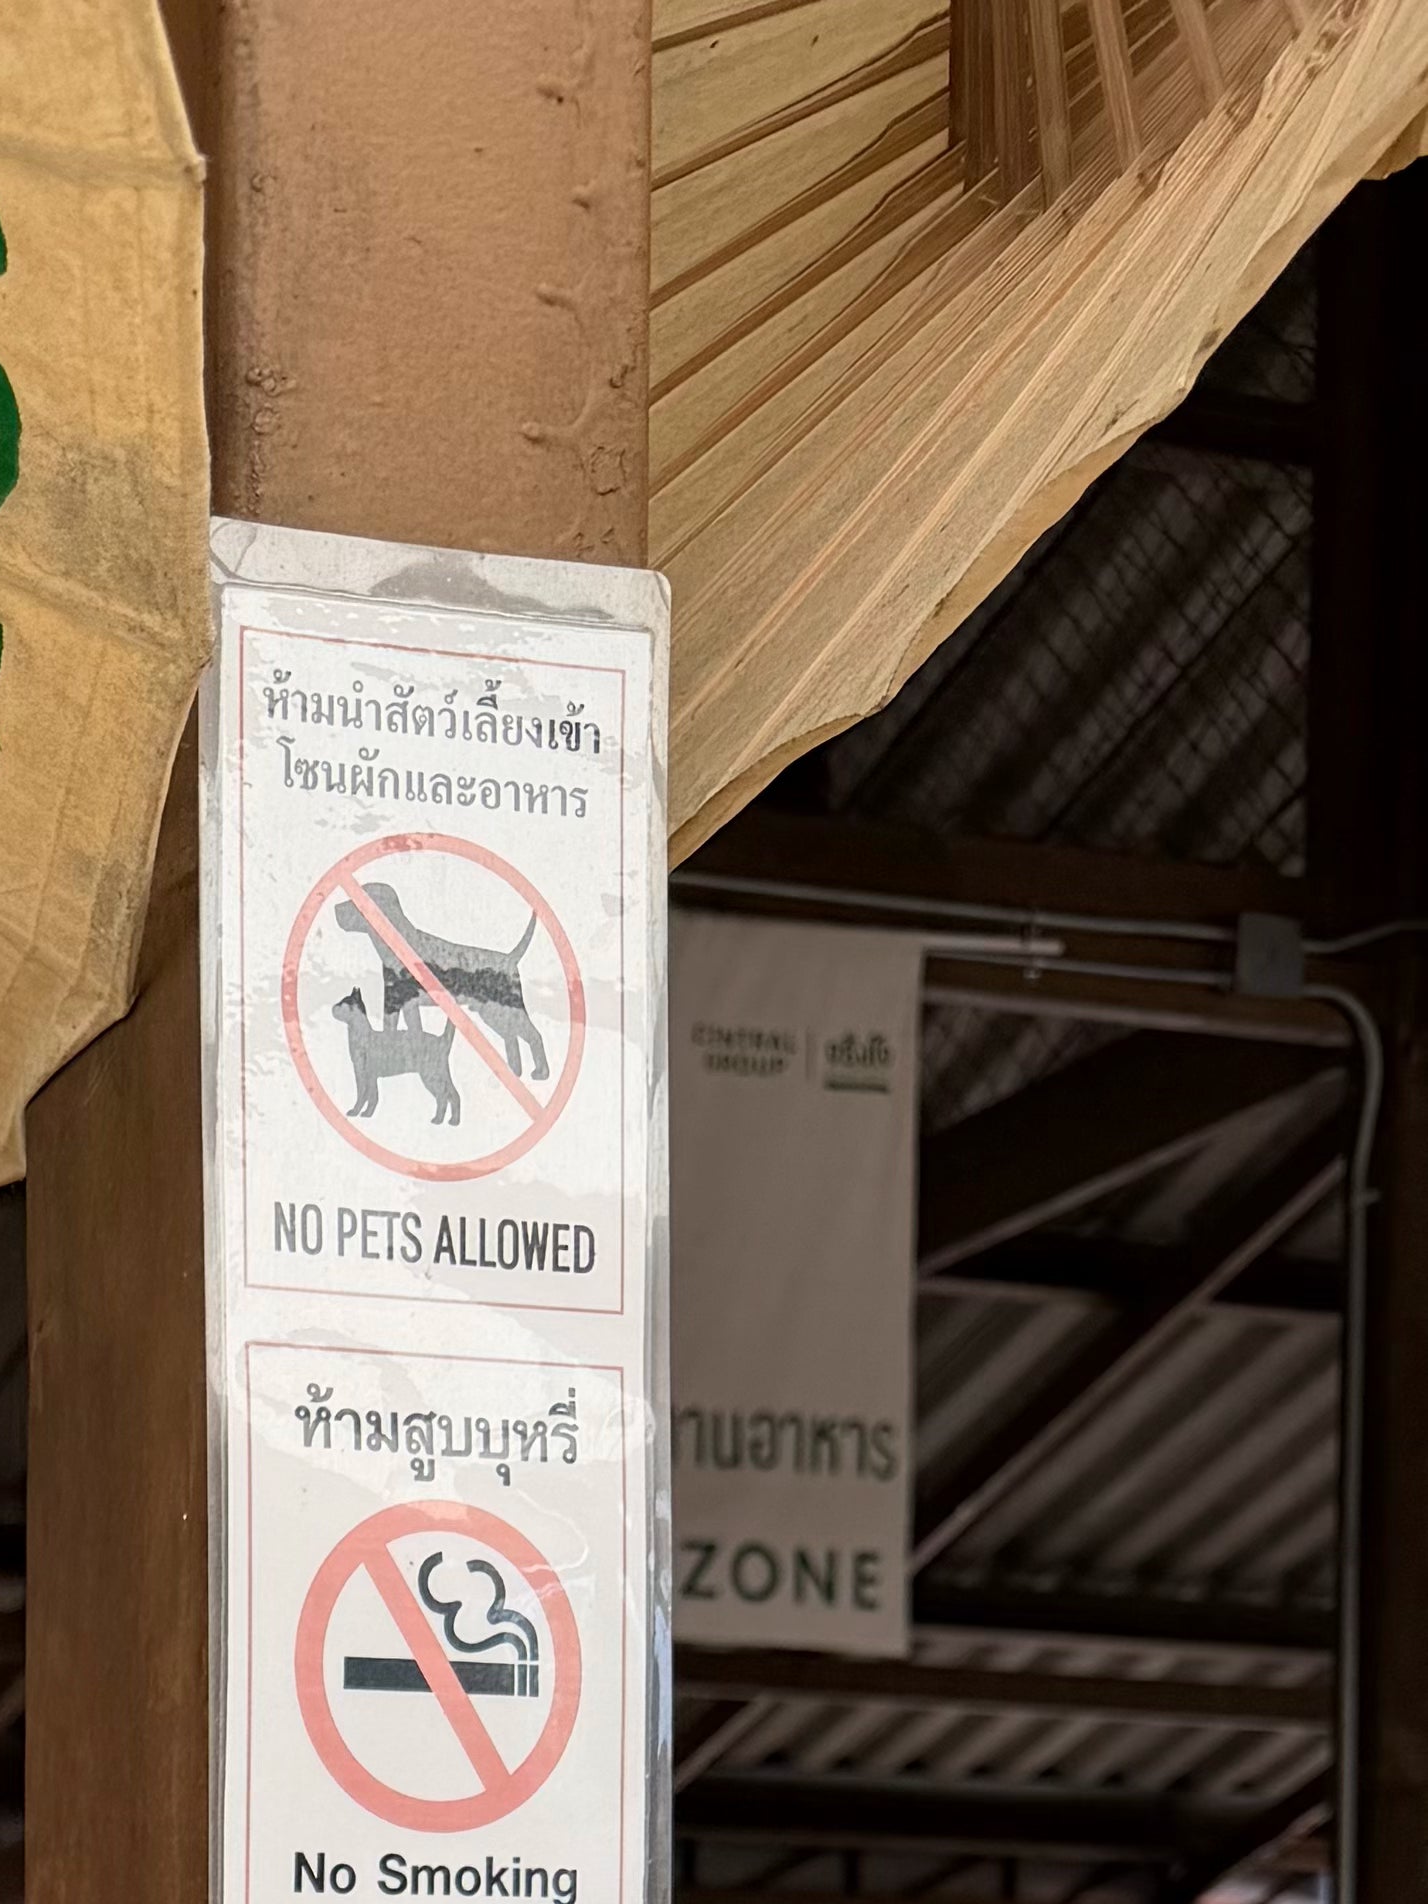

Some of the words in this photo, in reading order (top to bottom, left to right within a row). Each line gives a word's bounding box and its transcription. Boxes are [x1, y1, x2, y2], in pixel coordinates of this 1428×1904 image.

[262, 668, 601, 755] ห้ามนำสัตว์เลี้ยงเข้า
[275, 735, 589, 818] โซนผักและอาหาร
[273, 1200, 324, 1256] NO
[336, 1206, 423, 1265] PETS
[432, 1214, 595, 1275] ALLOWED
[293, 1381, 580, 1488] ห้ามสูบบุหรี่
[672, 1402, 899, 1483] านอาหาร
[679, 1534, 882, 1613] ZONE
[293, 1851, 357, 1894] No
